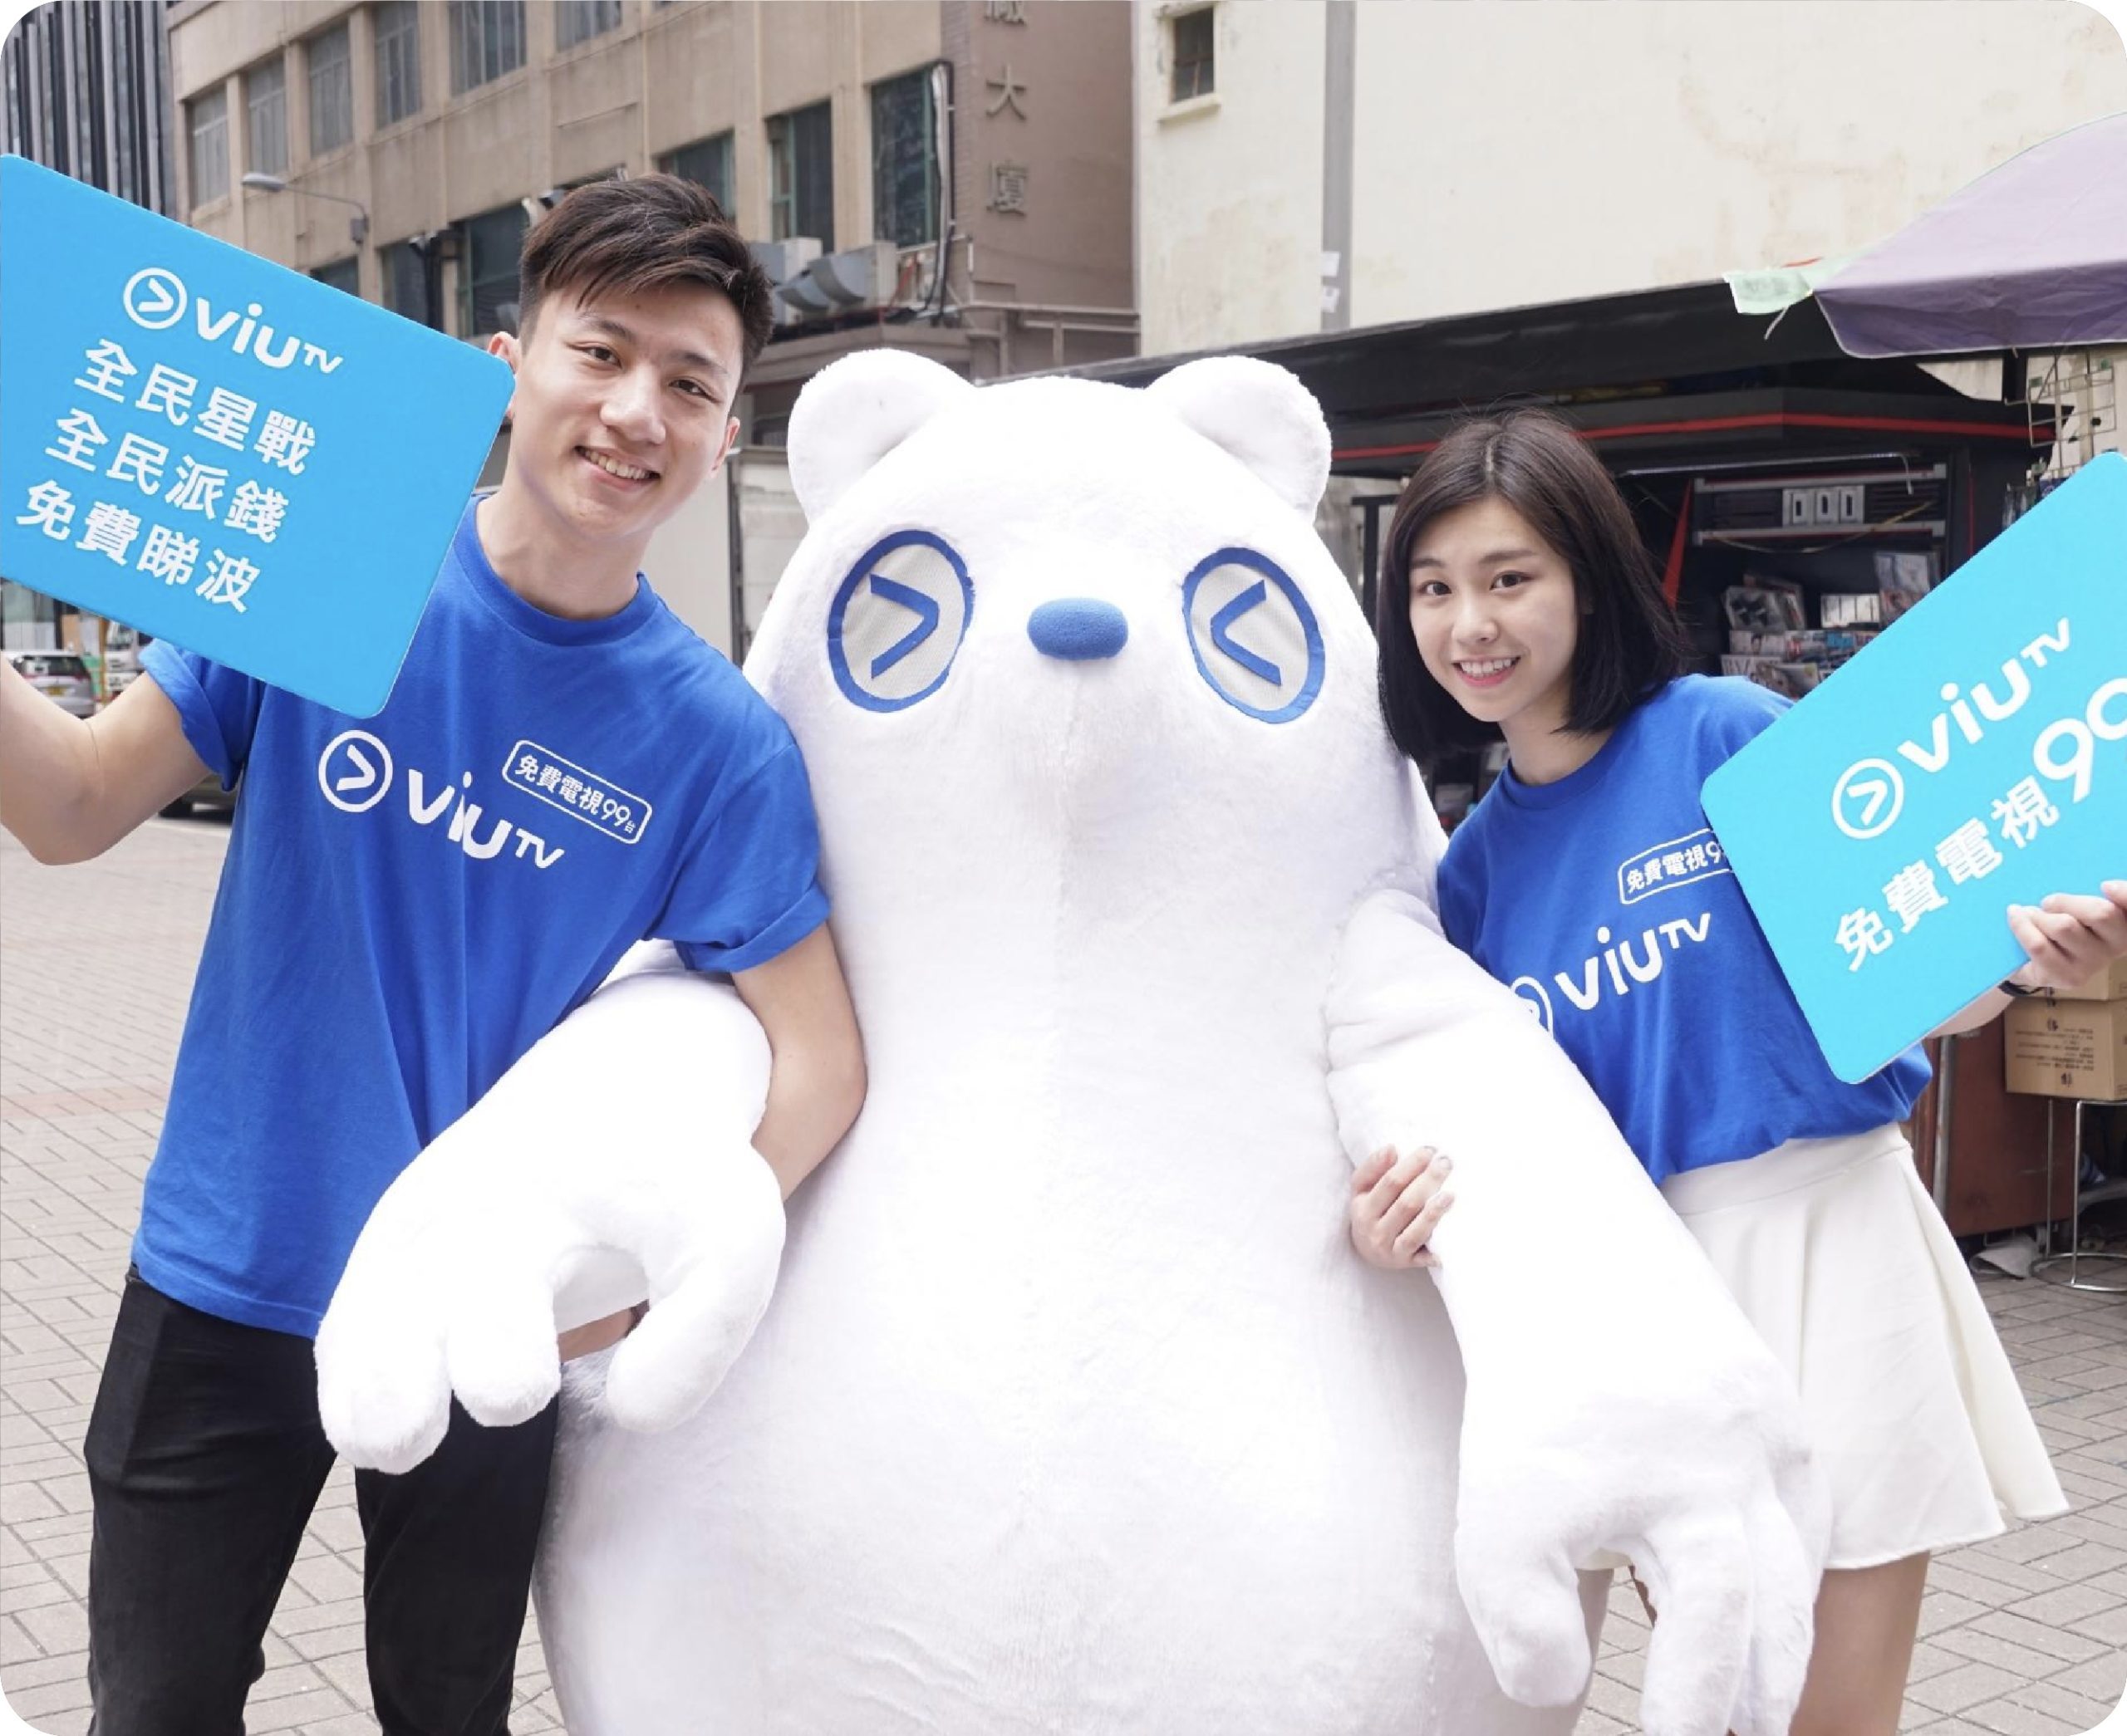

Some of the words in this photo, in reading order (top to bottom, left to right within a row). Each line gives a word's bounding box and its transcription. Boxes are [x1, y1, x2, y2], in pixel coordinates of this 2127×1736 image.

[197, 297, 343, 374] viuTV
[75, 338, 316, 475] 全民星戰
[45, 408, 289, 543] 全民派錢
[16, 480, 261, 613] 免費睇波
[1899, 617, 2071, 772] viuTV
[408, 768, 565, 869] viuTV
[1627, 841, 1728, 894] 免費電視9
[1555, 912, 1712, 1011] viuTV
